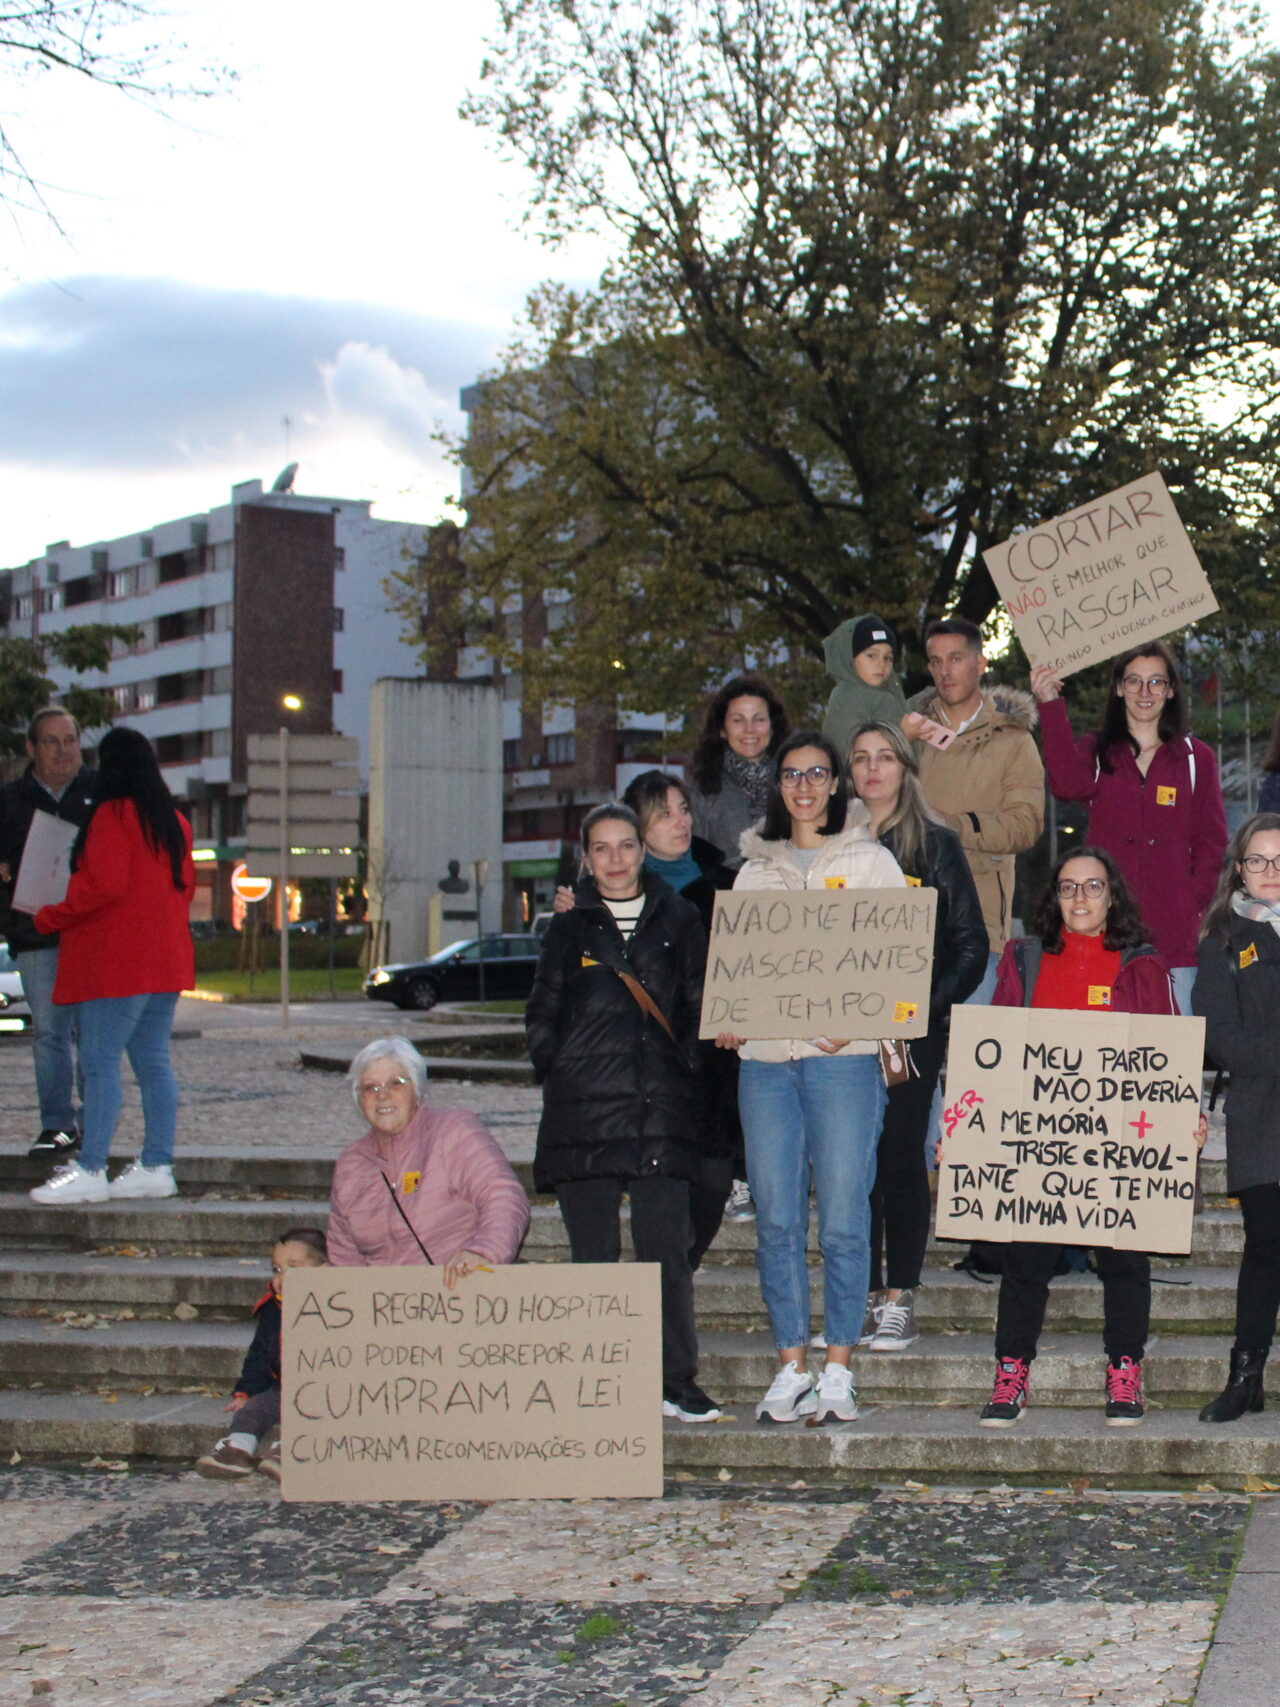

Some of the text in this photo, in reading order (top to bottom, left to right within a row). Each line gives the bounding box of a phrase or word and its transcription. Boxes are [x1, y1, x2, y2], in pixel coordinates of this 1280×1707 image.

[1007, 491, 1163, 583] CORTAR
[1006, 535, 1168, 620] NÃO É MELHOR QUE
[1037, 566, 1179, 647] RASGAR
[1047, 644, 1092, 670] EGUNDO
[802, 903, 840, 931] ME
[852, 901, 931, 934] FAÇAM
[836, 946, 928, 974] ANTES
[706, 996, 749, 1024] DE
[775, 992, 885, 1021] TEMPO
[975, 1038, 1168, 1073] O MEU PARTO
[943, 1090, 984, 1138] SER
[967, 1108, 985, 1133] A
[1100, 1141, 1188, 1170] REVOL-
[948, 1163, 1195, 1201] TANTE QUE TENHO
[948, 1197, 984, 1221] DA
[995, 1196, 1067, 1226] MINHA
[292, 1291, 354, 1329] AS
[372, 1291, 464, 1327] REGRAS
[475, 1294, 508, 1327] DO
[365, 1343, 443, 1368] PODEM
[457, 1343, 574, 1369] SOBREPOR
[582, 1344, 594, 1362] A
[294, 1376, 511, 1420] CUMPRAM
[524, 1379, 556, 1414] A
[291, 1434, 647, 1464] CUMPRAM RECOMENDAÇÕES OMS
